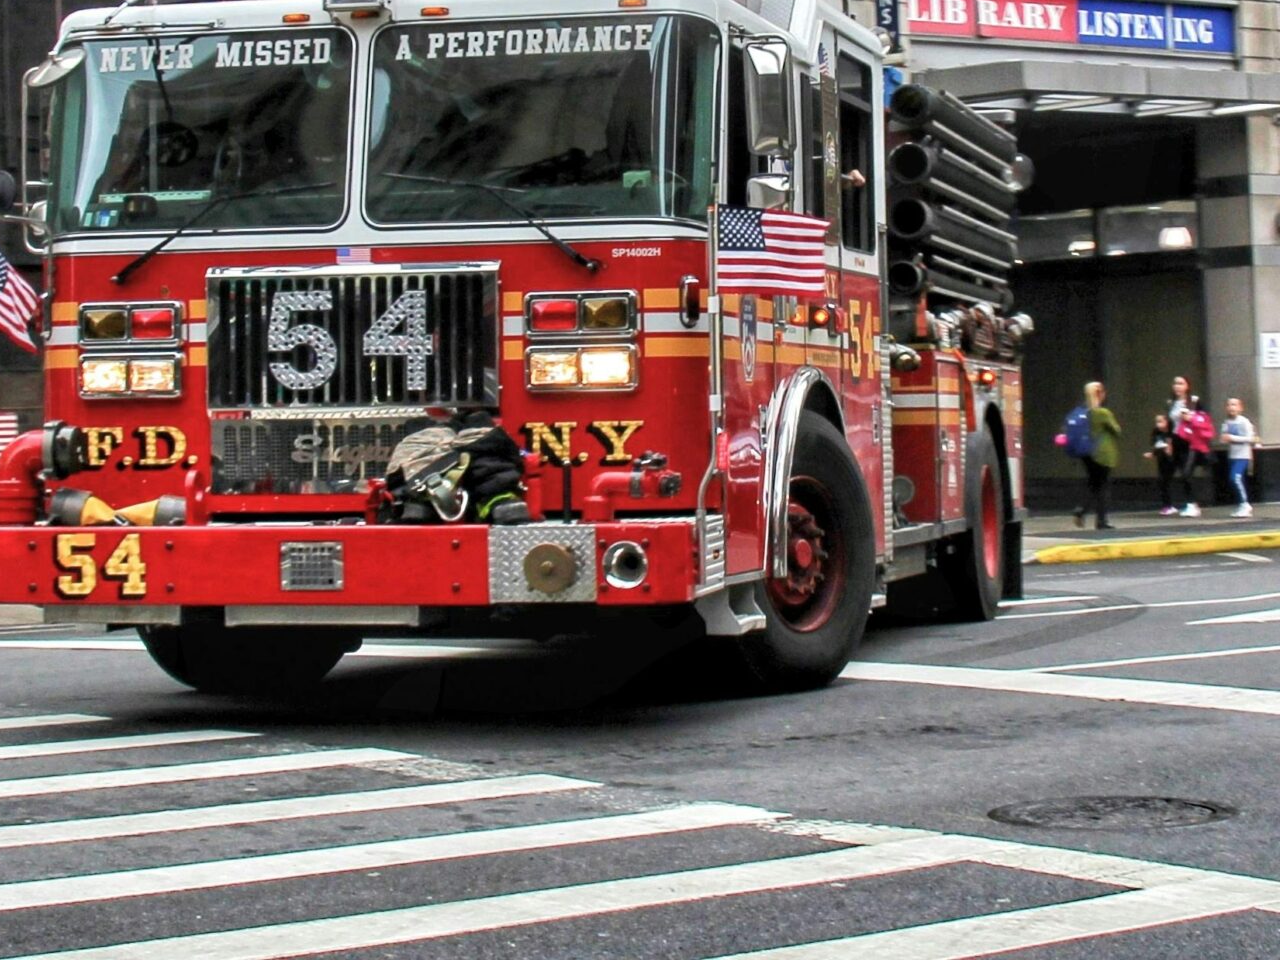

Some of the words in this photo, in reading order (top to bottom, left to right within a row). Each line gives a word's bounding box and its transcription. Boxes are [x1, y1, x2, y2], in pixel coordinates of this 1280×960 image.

[99, 43, 195, 73] NEVER
[215, 38, 331, 68] MISSED
[395, 34, 412, 61] A
[427, 24, 654, 59] PERFORMANCE
[1078, 9, 1214, 44] LISTENING
[611, 246, 662, 258] SP14002H
[267, 289, 433, 390] 54
[848, 298, 874, 379] 54
[81, 425, 199, 466] F.D.
[56, 532, 147, 596] 54
